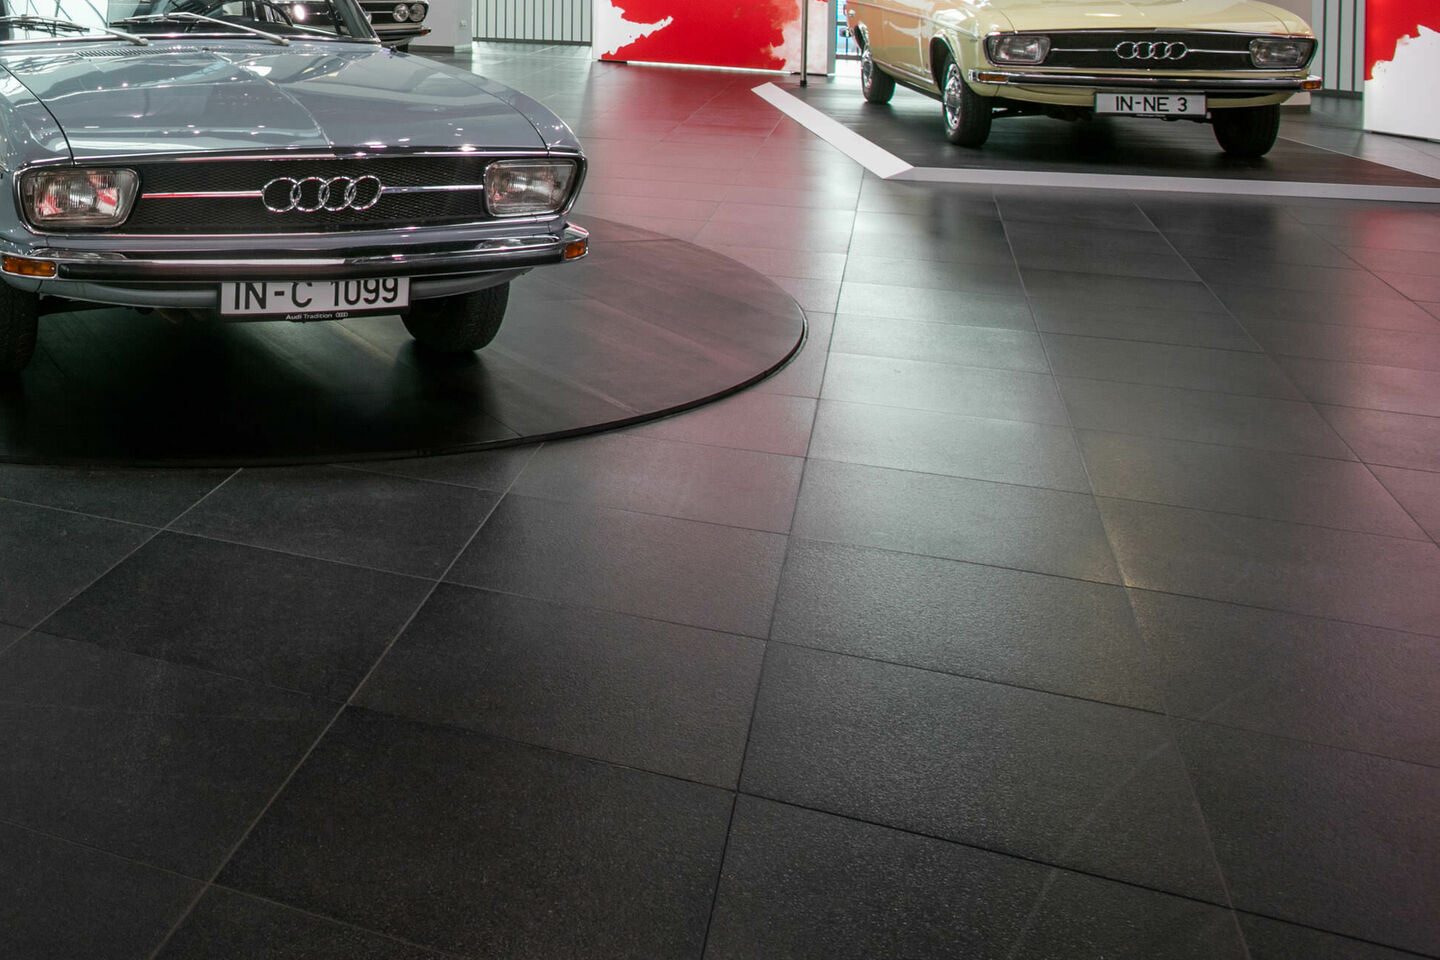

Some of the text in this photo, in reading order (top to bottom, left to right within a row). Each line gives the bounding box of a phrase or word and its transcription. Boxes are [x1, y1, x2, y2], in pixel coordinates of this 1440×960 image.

[1115, 95, 1188, 112] IN-NE 3
[330, 277, 399, 307] 1099
[304, 312, 333, 320] Tradition
